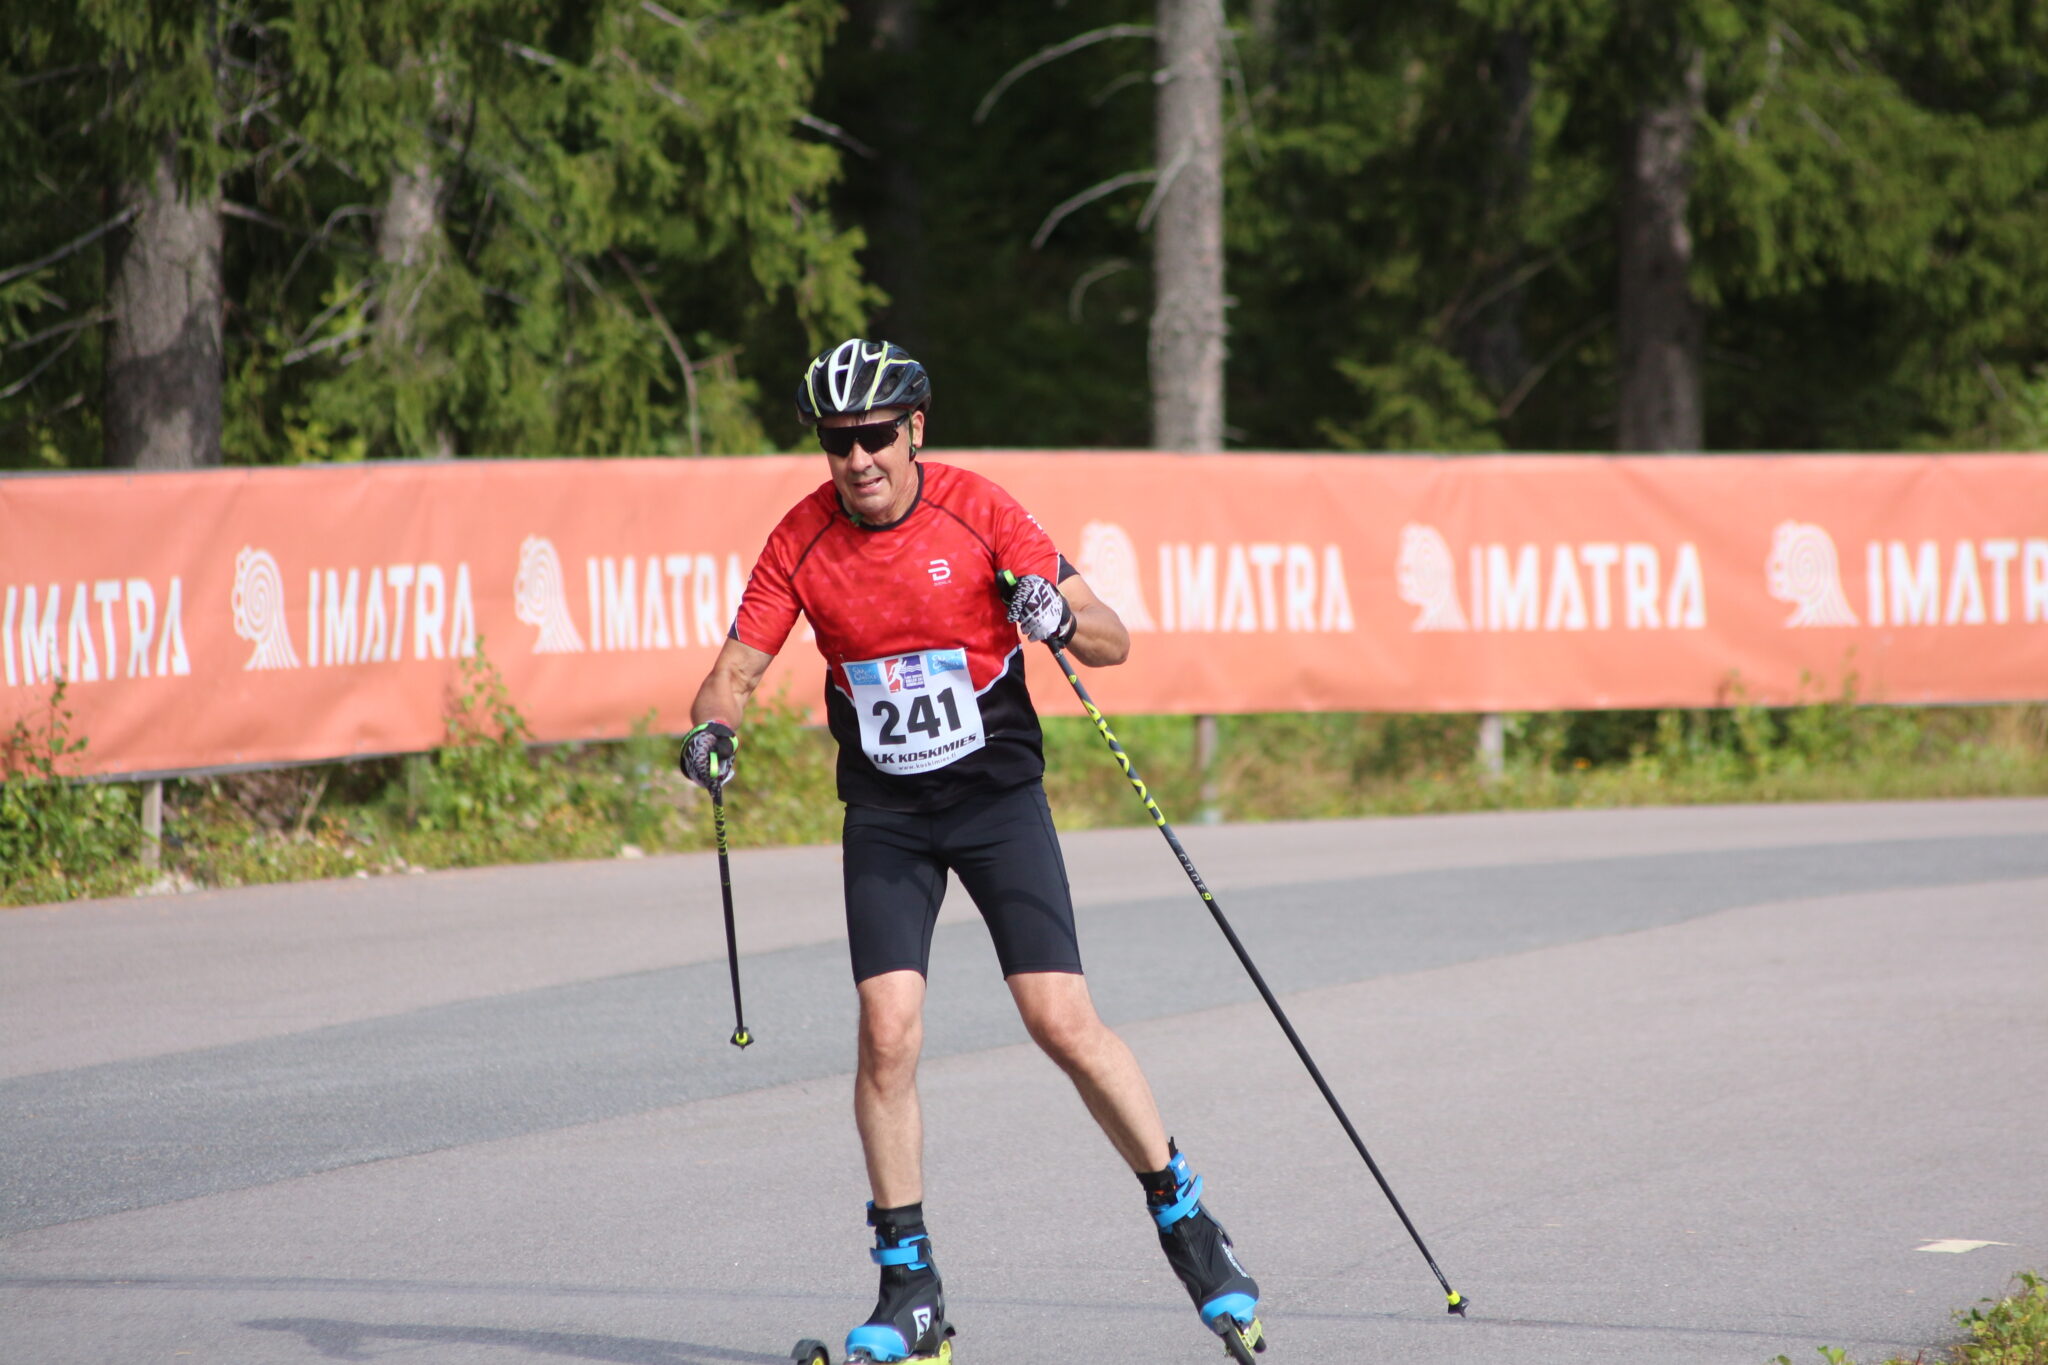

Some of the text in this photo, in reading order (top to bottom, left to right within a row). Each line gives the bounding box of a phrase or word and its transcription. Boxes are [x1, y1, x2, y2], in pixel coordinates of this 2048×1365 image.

[3, 576, 191, 686] IMATRA
[307, 562, 478, 668] IMATRA
[1158, 543, 1355, 632] IMATRA
[1469, 541, 1707, 632] IMATRA
[872, 687, 962, 746] 241
[898, 733, 977, 763] KOSKIMIES
